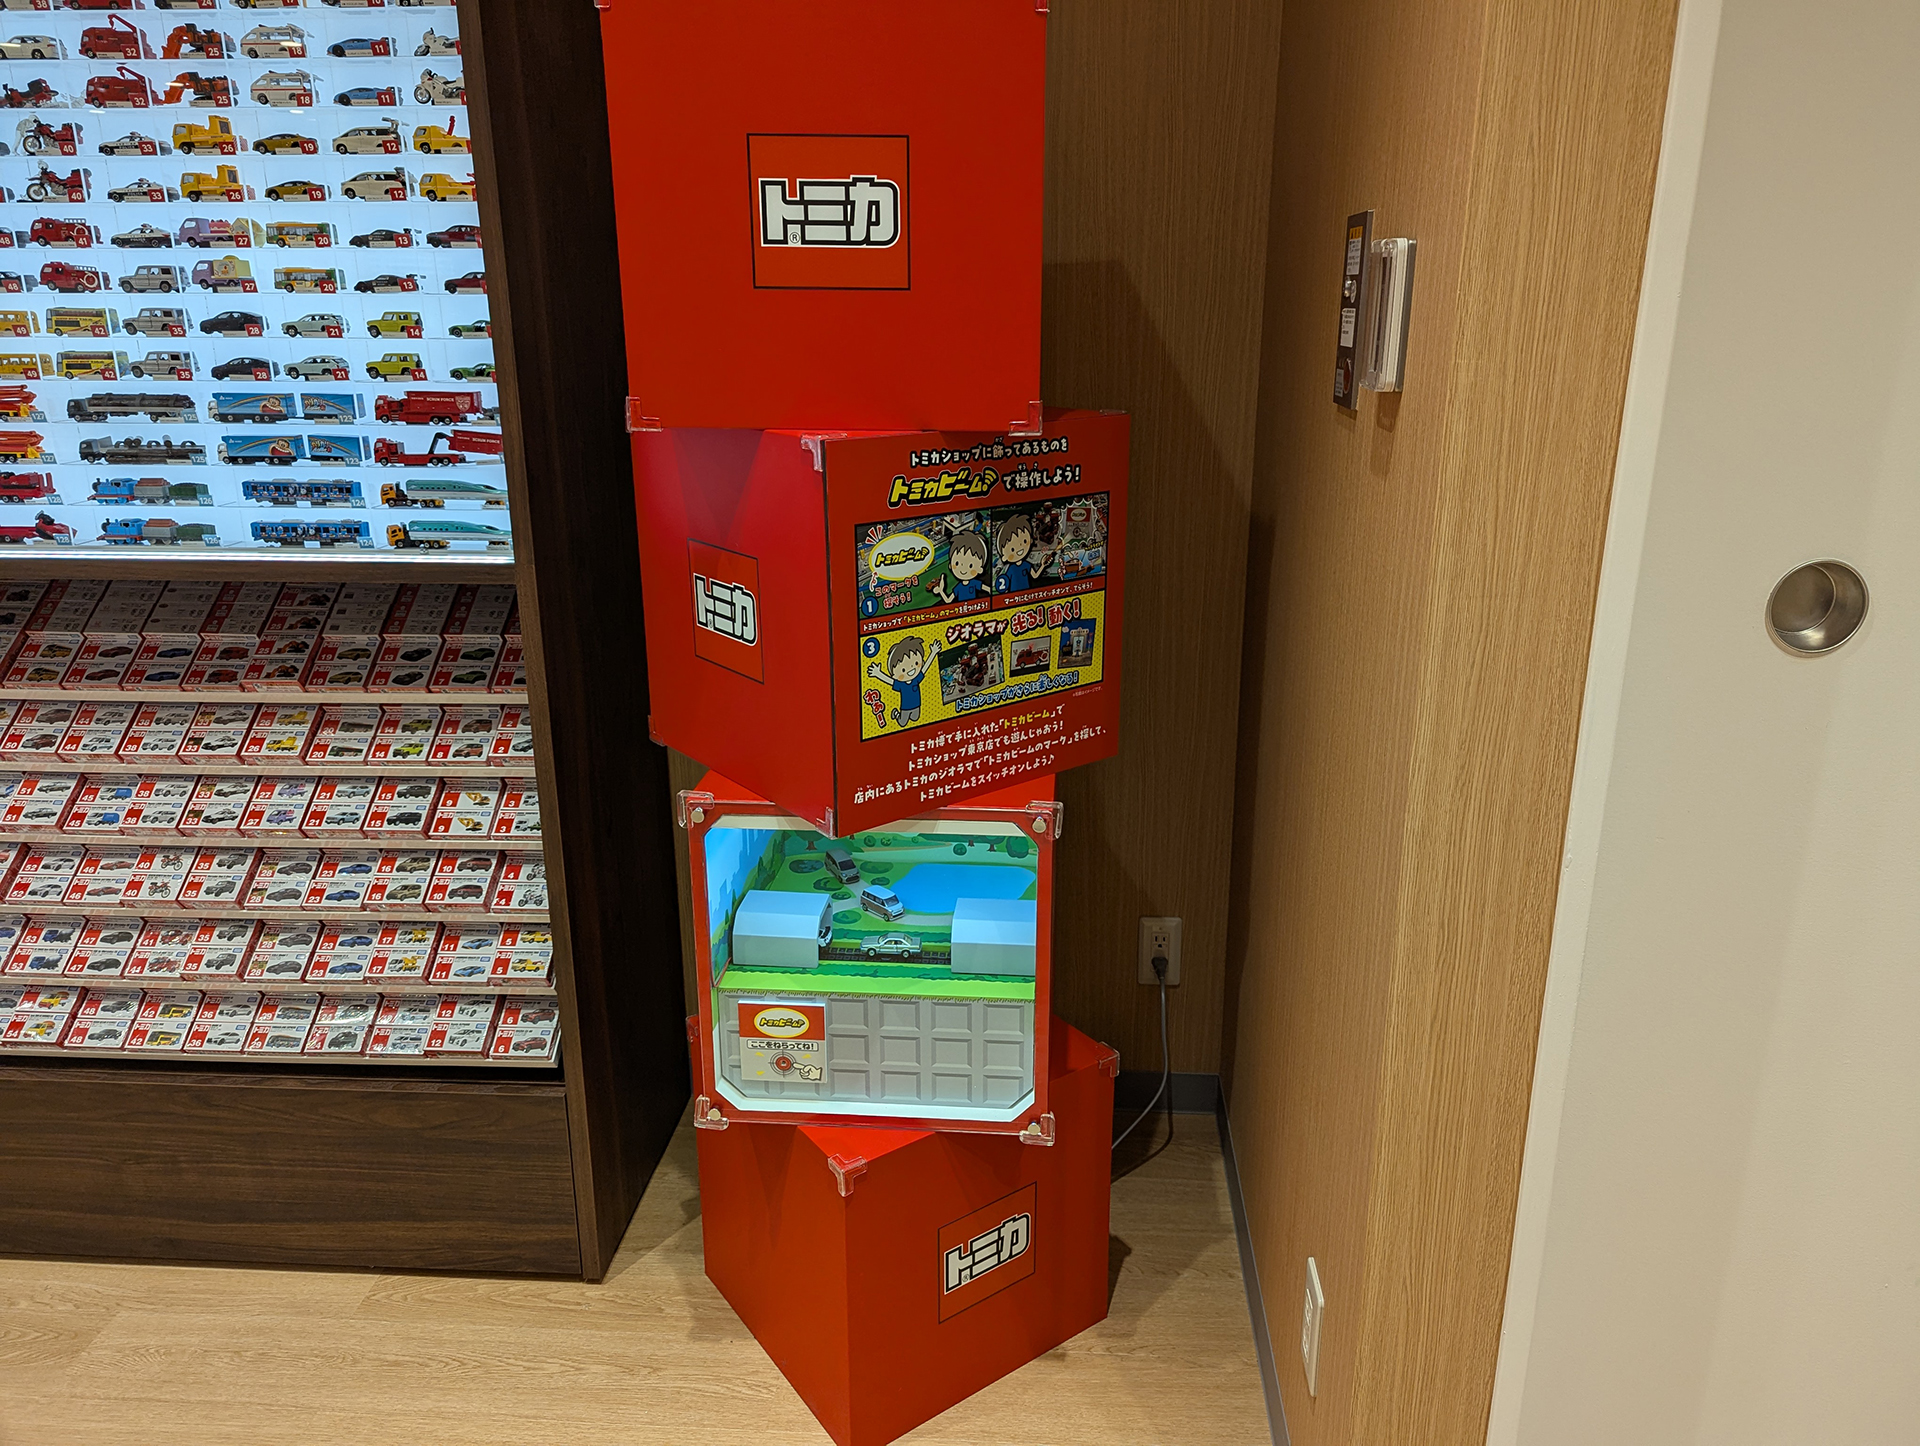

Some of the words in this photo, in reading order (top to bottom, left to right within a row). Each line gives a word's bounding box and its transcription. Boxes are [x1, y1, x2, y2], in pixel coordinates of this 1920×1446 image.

[125, 47, 138, 57] 32
[208, 47, 220, 56] 25
[292, 47, 302, 55] 18
[374, 44, 384, 53] 11
[134, 97, 146, 106] 32
[216, 95, 229, 104] 25
[300, 96, 310, 104] 18
[380, 94, 390, 103] 11
[63, 144, 74, 153] 40
[142, 144, 153, 152] 33
[222, 144, 234, 153] 26
[304, 143, 314, 152] 19
[386, 142, 398, 151] 12
[71, 192, 82, 200] 40
[151, 191, 162, 200] 33
[229, 191, 241, 200] 26
[311, 190, 322, 199] 19
[393, 190, 404, 198] 12
[758, 176, 900, 248] トミカ
[78, 237, 88, 245] 41
[237, 237, 248, 246] 27
[317, 236, 329, 245] 20
[398, 236, 409, 245] 13
[8, 282, 19, 291] 48
[244, 282, 255, 291] 27
[322, 283, 334, 292] 20
[403, 281, 414, 290] 13
[16, 326, 27, 334] 49
[94, 327, 106, 335] 42
[172, 327, 184, 335] 35
[248, 326, 260, 335] 28
[329, 328, 340, 336] 21
[410, 328, 420, 336] 14
[27, 370, 38, 378] 49
[104, 370, 115, 378] 42
[179, 371, 191, 379] 35
[256, 371, 268, 380] 28
[336, 370, 346, 379] 21
[414, 371, 425, 379] 14
[184, 413, 196, 421] 125
[911, 438, 1068, 466] トミカショップに飾ってあるものを
[890, 469, 990, 503] トミカビーム
[1004, 467, 1080, 490] で操作しよう!
[48, 496, 62, 504] 128
[199, 497, 213, 505] 126
[351, 499, 366, 507] 124
[876, 548, 928, 566] トミカビーム
[875, 576, 918, 596] このマークを
[998, 578, 1006, 590] 2
[1004, 582, 1092, 604] マークにむけてスイッチオンで、てらそう!
[884, 592, 912, 608] 探そう!
[694, 573, 758, 646] トミカ
[867, 601, 872, 612] 1
[864, 602, 988, 631] トミカショップで「トミカビーム」のマークを見つけよう!
[946, 620, 1007, 642] ジオラマが
[1012, 607, 1043, 634] 光る!
[1048, 600, 1079, 627] 動く!
[867, 641, 876, 654] 3
[956, 672, 1078, 710] トミカショップがさらに楽しくなる!
[910, 704, 1065, 754] トミカ博で手に入れた「トミカビーム」で
[125, 744, 138, 752] 38
[497, 746, 505, 754] 2
[908, 721, 1064, 771] トミカショップ東京店でも遊んじゃおう!
[854, 726, 1106, 804] 店内にあるトミカのジオラマで「トミカビームのマーク」を探して、
[4, 814, 17, 822] 51
[186, 817, 198, 825] 33
[438, 825, 445, 833] 9
[10, 890, 24, 898] 52
[69, 892, 82, 900] 46
[125, 889, 138, 897] 40
[184, 890, 198, 898] 35
[371, 892, 382, 900] 16
[433, 892, 443, 900] 10
[307, 896, 320, 904] 23
[499, 898, 506, 906] 4
[70, 964, 83, 972] 47
[185, 962, 198, 970] 35
[496, 966, 503, 974] 5
[249, 968, 262, 976] 28
[6, 1030, 19, 1038] 54
[70, 1036, 83, 1044] 48
[130, 1037, 143, 1046] 42
[431, 1039, 442, 1047] 12
[498, 1045, 505, 1053] 6
[751, 1041, 814, 1050] ここをねらってね!
[944, 1213, 1030, 1294] トミカ
